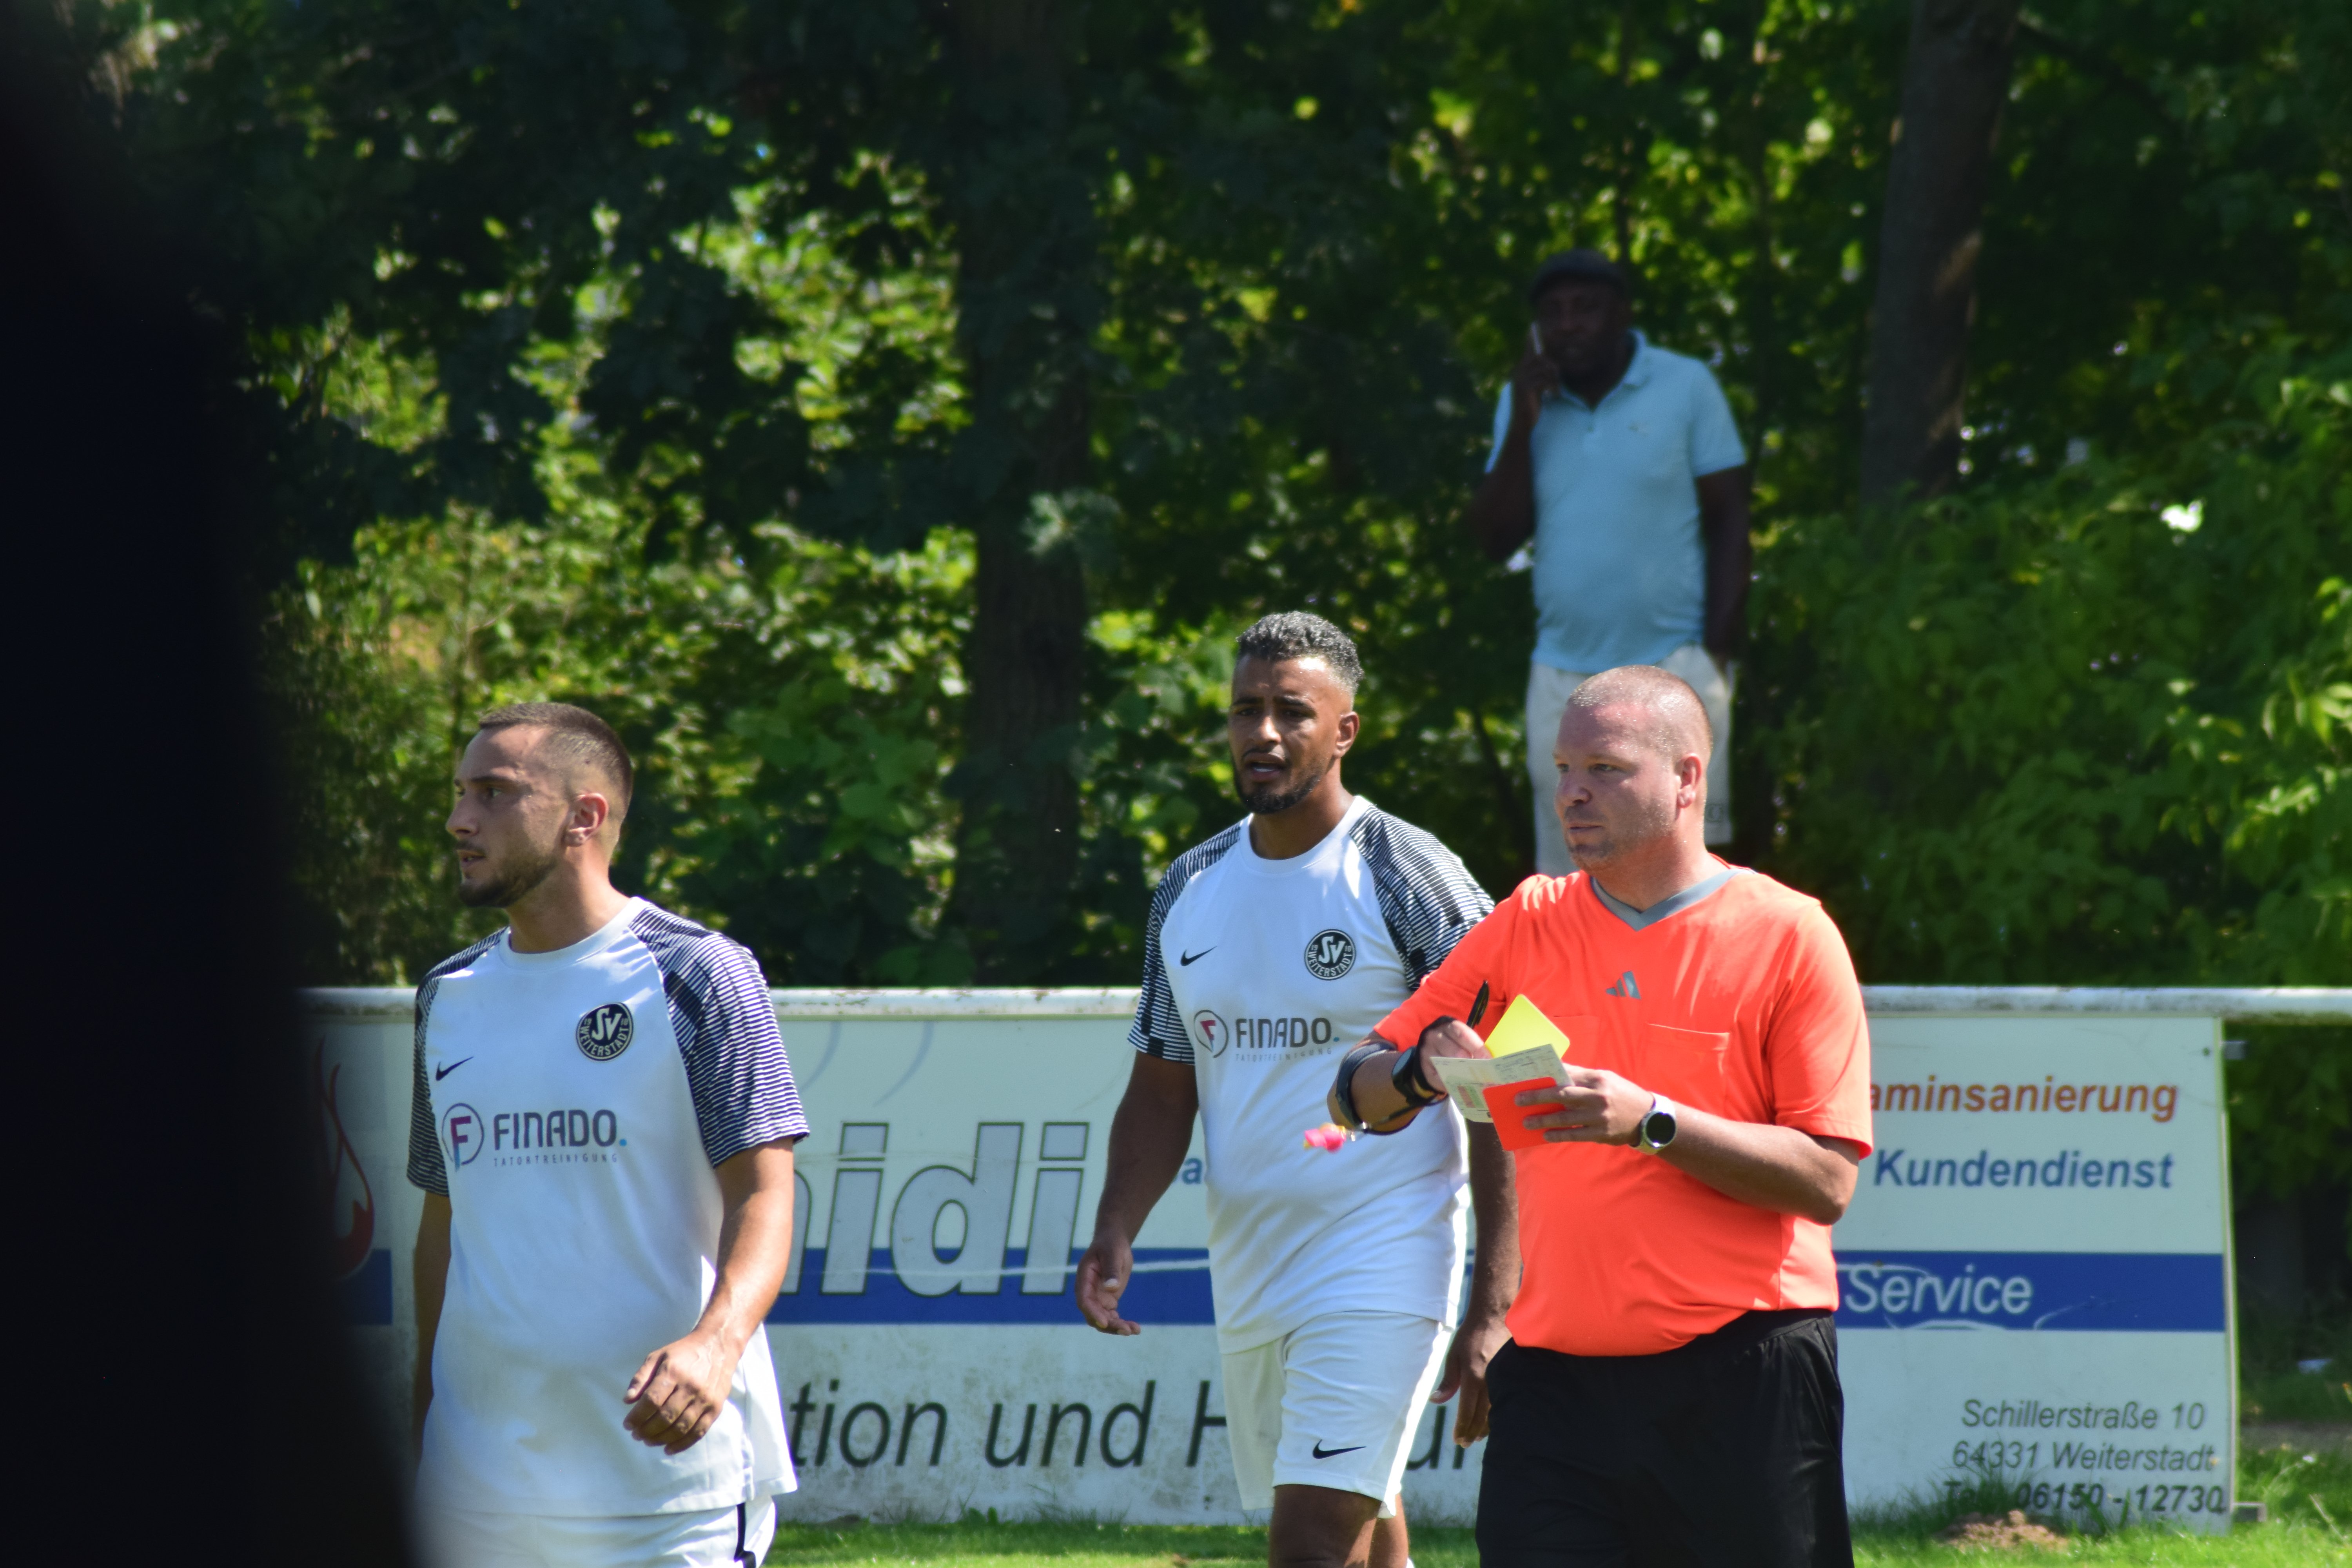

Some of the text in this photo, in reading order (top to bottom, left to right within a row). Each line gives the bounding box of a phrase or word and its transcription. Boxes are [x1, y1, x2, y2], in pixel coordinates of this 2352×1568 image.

[1307, 951, 1353, 976] WEITERSTADT
[1318, 936, 1346, 964] SV
[592, 1007, 622, 1040] SV
[580, 1025, 628, 1056] WEITERSTADT
[494, 1154, 617, 1167] TATORTREINIGUNG
[1873, 1149, 2174, 1189] Kundendienst
[1845, 1263, 2033, 1314] Service
[984, 1380, 1156, 1468] und
[1962, 1399, 2205, 1430] Schillerstraße 10
[1953, 1441, 2215, 1472] 64331 Weiterstadt
[2015, 1483, 2105, 1510] 06150
